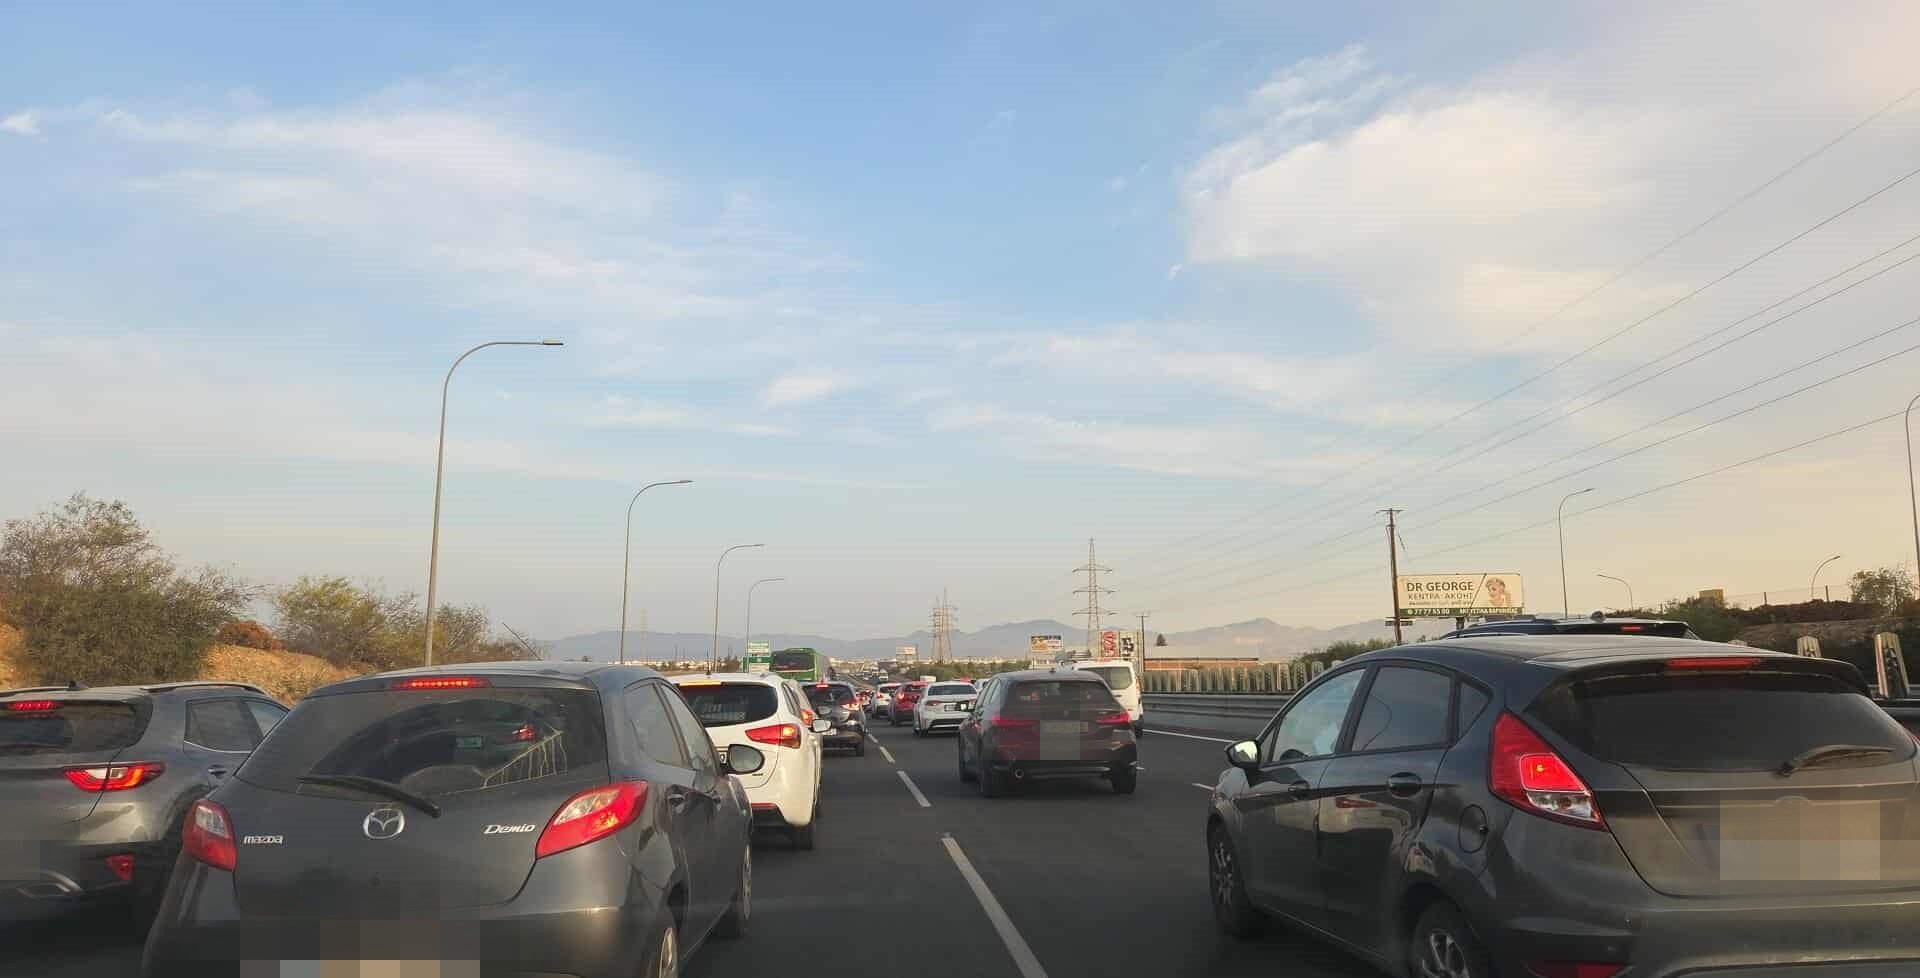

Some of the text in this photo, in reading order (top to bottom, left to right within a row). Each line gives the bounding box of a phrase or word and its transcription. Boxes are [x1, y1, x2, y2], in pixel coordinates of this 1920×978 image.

[1407, 581, 1472, 591] DR GEORGE
[483, 823, 536, 834] Demio
[243, 835, 283, 845] mazda
